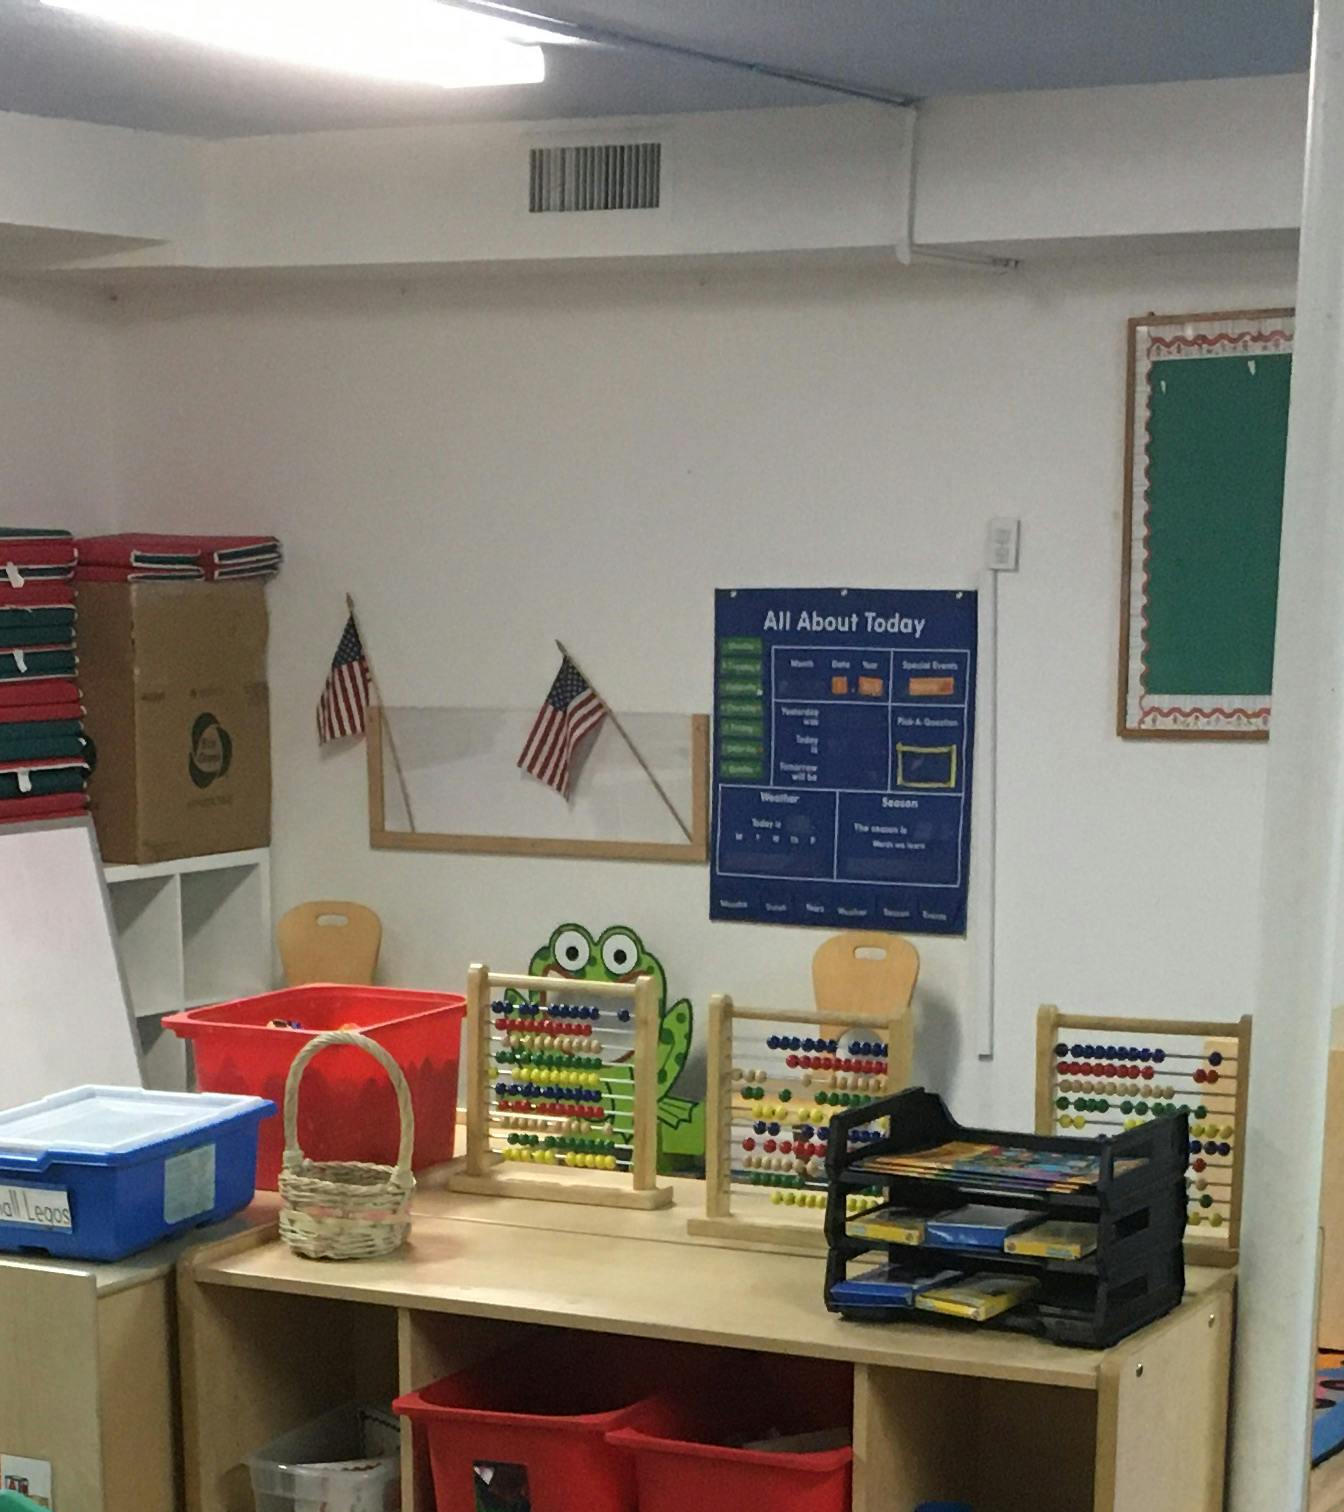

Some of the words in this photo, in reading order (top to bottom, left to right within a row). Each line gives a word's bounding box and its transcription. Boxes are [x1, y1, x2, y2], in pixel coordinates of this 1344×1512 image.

[763, 610, 790, 631] All
[797, 610, 858, 633] About
[864, 612, 926, 638] Today
[760, 791, 800, 804] Weather
[881, 797, 919, 809] Season
[22, 1190, 70, 1226] Legos
